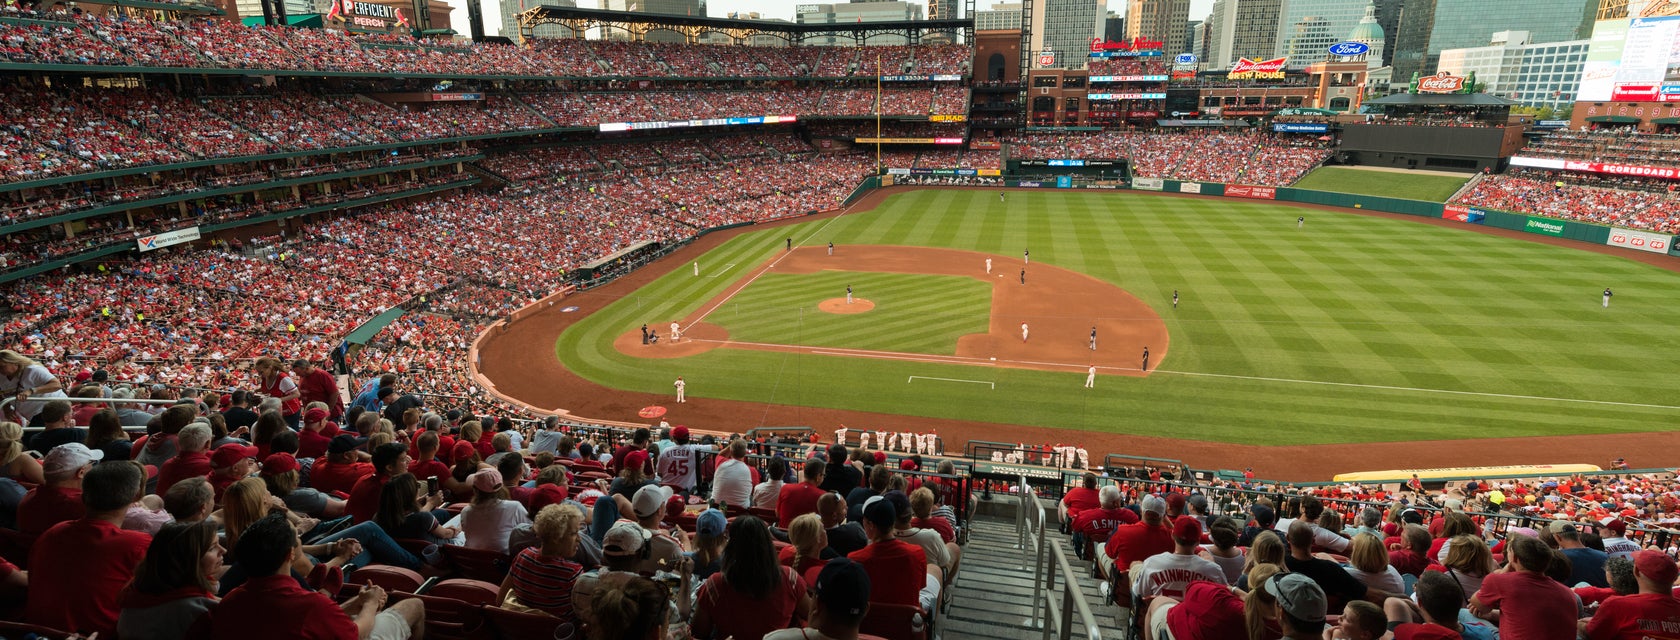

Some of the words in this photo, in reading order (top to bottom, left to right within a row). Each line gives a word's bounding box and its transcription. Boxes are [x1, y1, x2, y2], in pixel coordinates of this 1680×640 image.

[341, 0, 393, 18] PERFICIENT
[354, 17, 385, 27] PERCH
[1091, 38, 1129, 52] Cardinals
[1129, 37, 1163, 51] Nation
[1337, 44, 1361, 54] Ford
[1235, 61, 1284, 71] Budweiser
[1228, 72, 1253, 80] BREW
[1255, 71, 1286, 79] HOUSE
[1422, 78, 1458, 89] Coca-Cola
[1606, 107, 1612, 116] 1
[1619, 107, 1628, 116] 2
[1635, 107, 1644, 117] 6
[1652, 107, 1661, 117] 9
[1603, 164, 1673, 177] SCOREBOARD
[1463, 207, 1485, 216] America
[1535, 221, 1563, 230] National
[666, 448, 690, 458] GIBSON
[667, 459, 689, 476] 45
[991, 465, 1029, 473] WORLD
[1151, 568, 1212, 587] WAINWRIG
